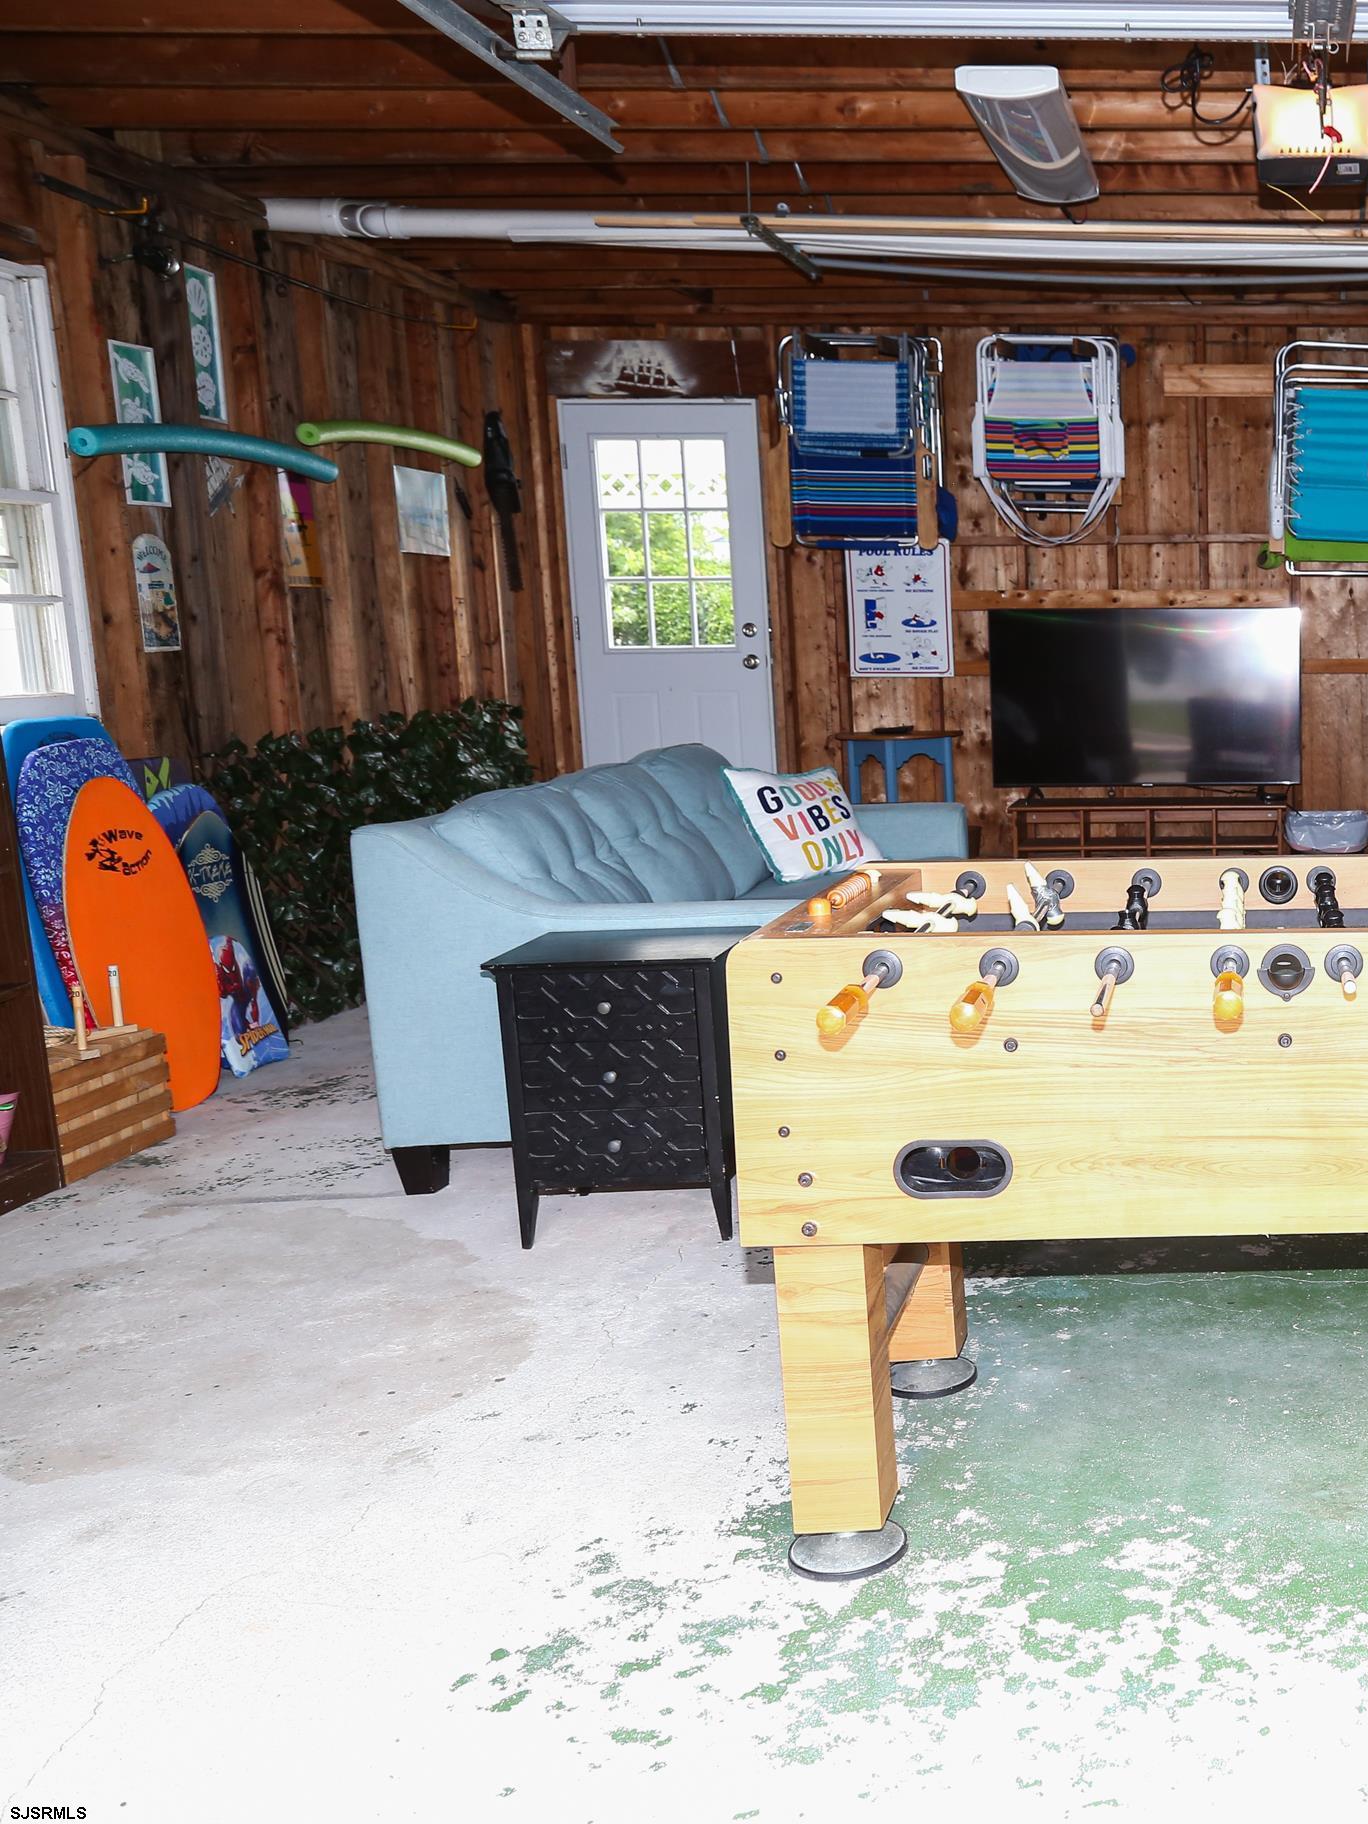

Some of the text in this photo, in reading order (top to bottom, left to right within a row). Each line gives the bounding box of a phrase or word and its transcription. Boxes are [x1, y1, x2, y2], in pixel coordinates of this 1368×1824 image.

[894, 547, 934, 556] RULES
[757, 781, 828, 814] GOOD
[773, 795, 851, 841] VIBES
[102, 829, 144, 844] Wave
[802, 829, 864, 871] ONLY
